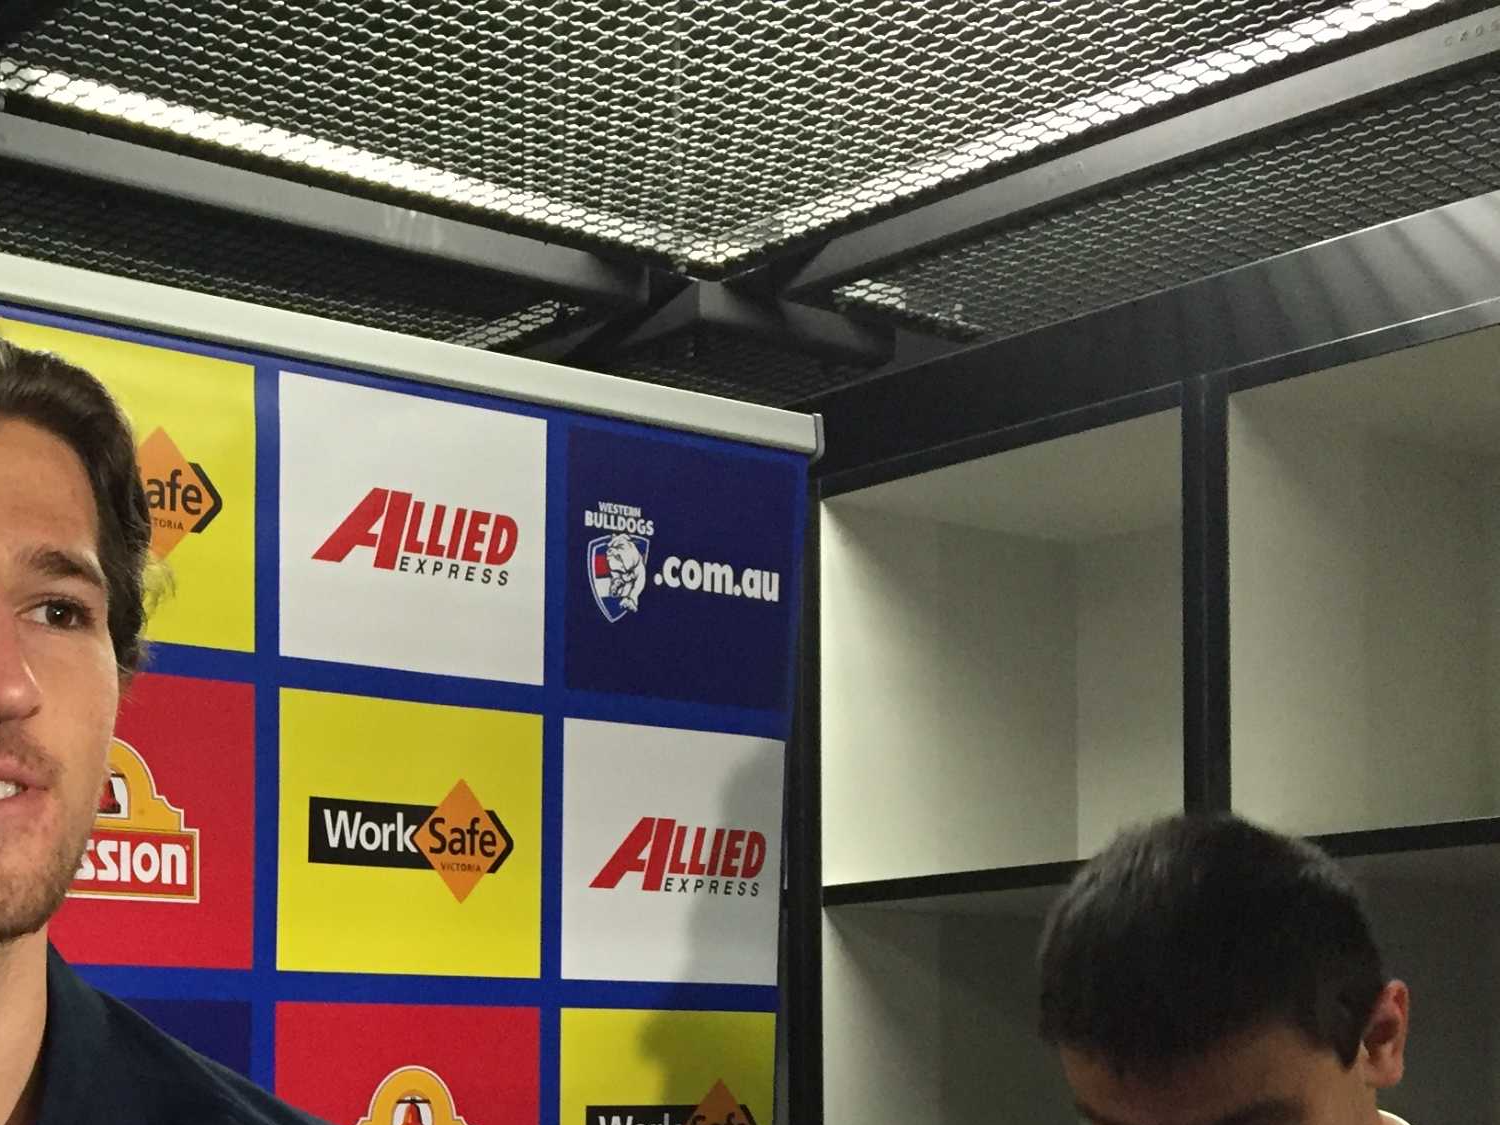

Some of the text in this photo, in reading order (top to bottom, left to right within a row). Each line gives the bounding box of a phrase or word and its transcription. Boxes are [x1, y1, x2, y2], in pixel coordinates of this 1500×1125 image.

[146, 468, 202, 515] afe
[584, 510, 654, 536] BULLDOGS
[598, 501, 641, 518] WESTERN
[311, 487, 518, 570] ALLIED
[399, 556, 509, 586] EXPRESS
[654, 556, 780, 602] .com.au
[440, 861, 482, 873] VICTORIA
[588, 816, 766, 891] ALLIED
[663, 878, 760, 897] EXPRESS
